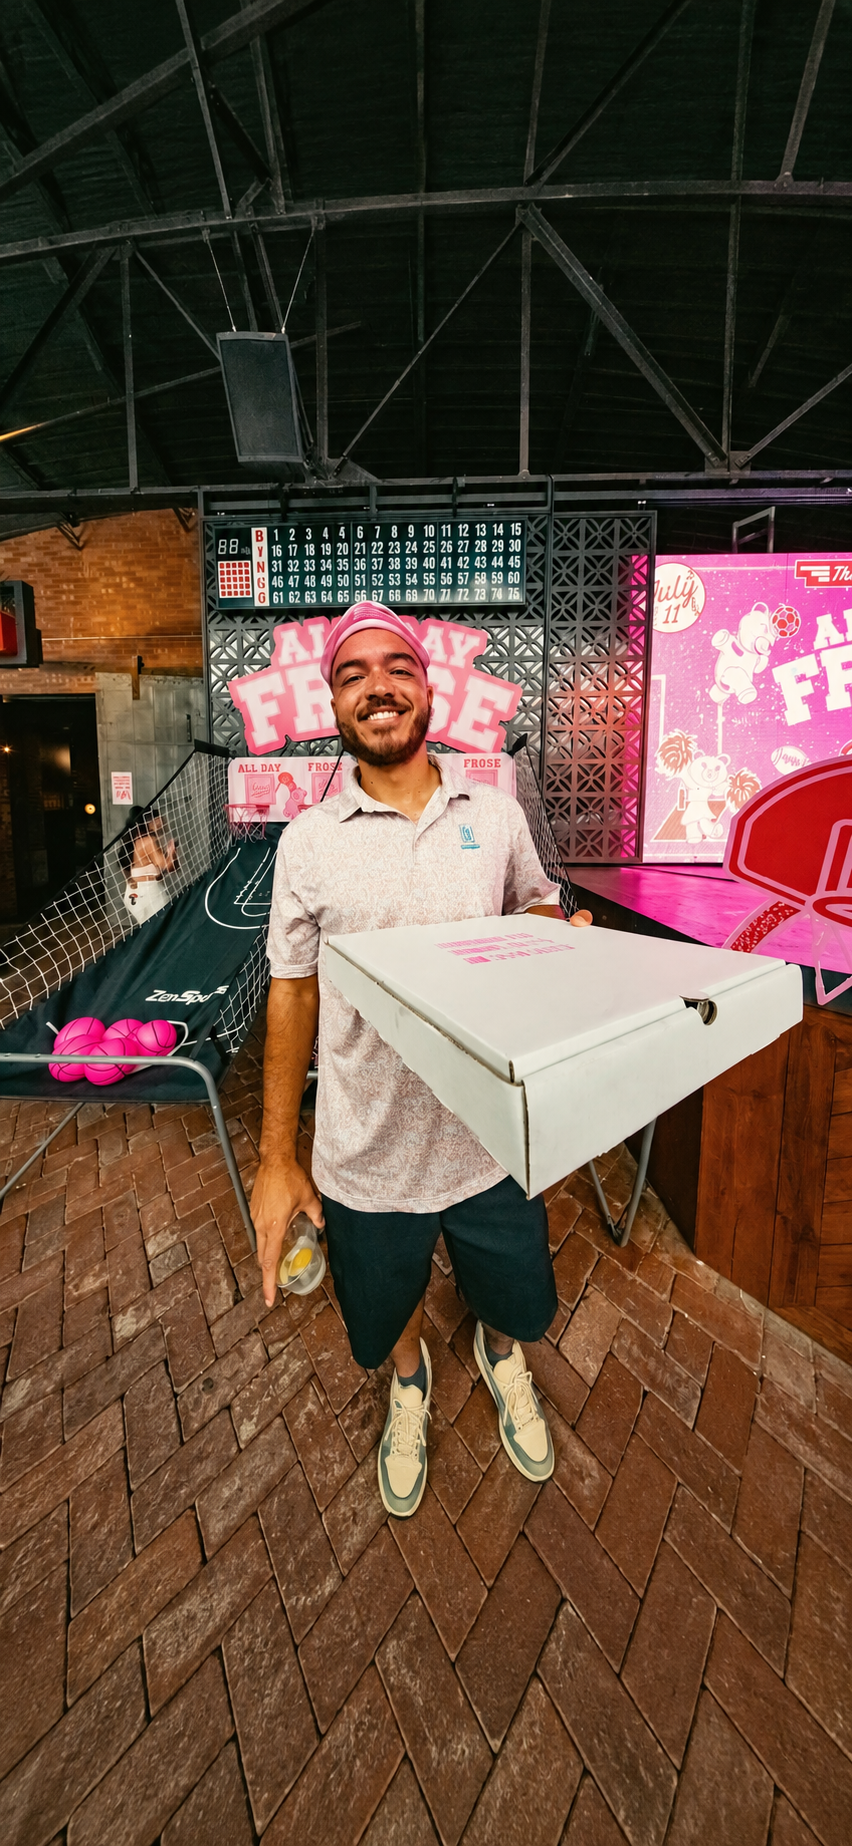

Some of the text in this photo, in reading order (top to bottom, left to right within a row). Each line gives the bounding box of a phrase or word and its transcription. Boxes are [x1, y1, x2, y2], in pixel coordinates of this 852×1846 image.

[273, 528, 279, 542] 1
[289, 528, 296, 541] 2
[305, 527, 312, 540] 3
[322, 526, 329, 540] 4
[356, 525, 364, 539] 6
[374, 525, 381, 539] 7
[391, 525, 398, 539] 8
[407, 524, 415, 538] 9
[423, 524, 435, 538] 10
[440, 524, 452, 538] 11
[457, 523, 470, 537] 12
[475, 523, 487, 537] 13
[492, 523, 504, 537] 14
[510, 522, 522, 536] 15
[217, 538, 239, 555] 88
[271, 539, 521, 557] 16 17 18 19 20 21 22 23 24 25 26 27 28 29 30
[271, 555, 521, 573] 31 32 33 34 35 36 37 38 39 40 41 42 43 44 45
[271, 571, 520, 588] 46 47 48 49 50 51 52 53 54 55 56 57 58 59 60
[272, 591, 284, 604] 61
[288, 591, 301, 604] 62
[304, 591, 317, 604] 63
[321, 590, 333, 604] 64
[337, 590, 350, 603] 65
[354, 589, 367, 602] 66
[371, 589, 384, 602] 67
[422, 588, 435, 602] 70
[456, 588, 470, 601] 72
[474, 588, 486, 601] 73
[507, 587, 520, 600] 75
[662, 603, 681, 624] 11
[278, 622, 480, 669] AL AY
[236, 662, 515, 753] FRSE
[238, 763, 282, 773] ALL DAY
[463, 758, 502, 769] FROSE
